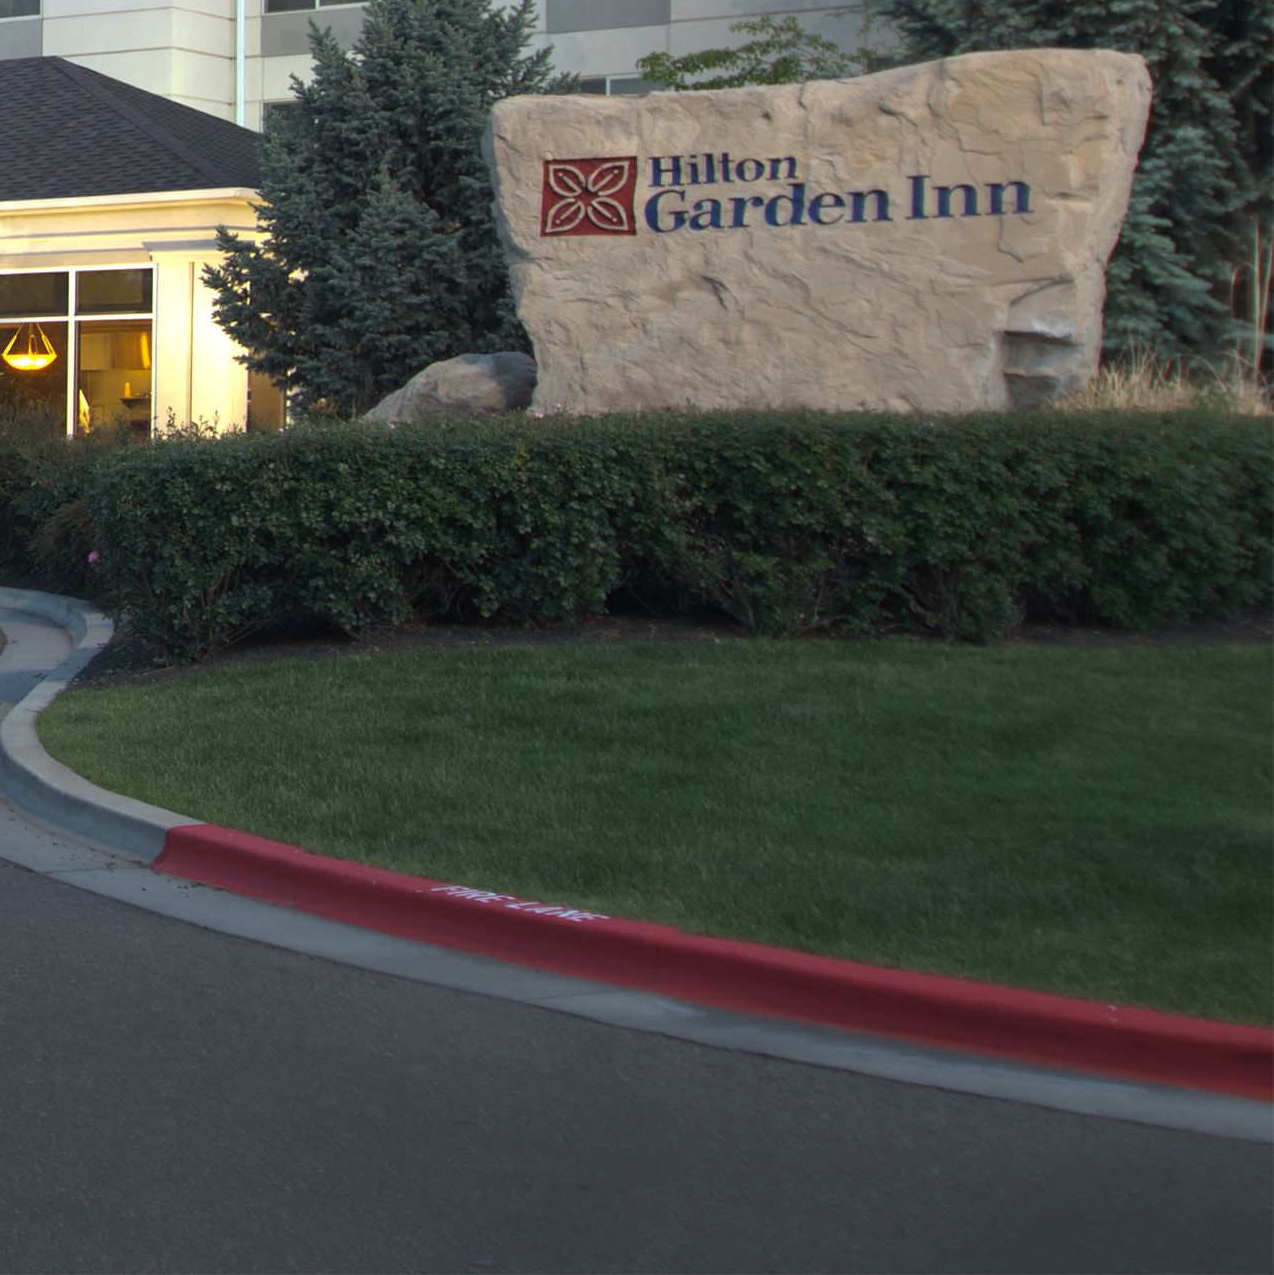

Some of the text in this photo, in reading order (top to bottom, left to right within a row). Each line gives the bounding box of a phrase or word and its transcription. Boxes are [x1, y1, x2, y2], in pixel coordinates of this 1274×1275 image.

[648, 152, 799, 187] Hilton
[644, 174, 1035, 234] Garden Inn
[430, 885, 611, 922] FIRE LANE
